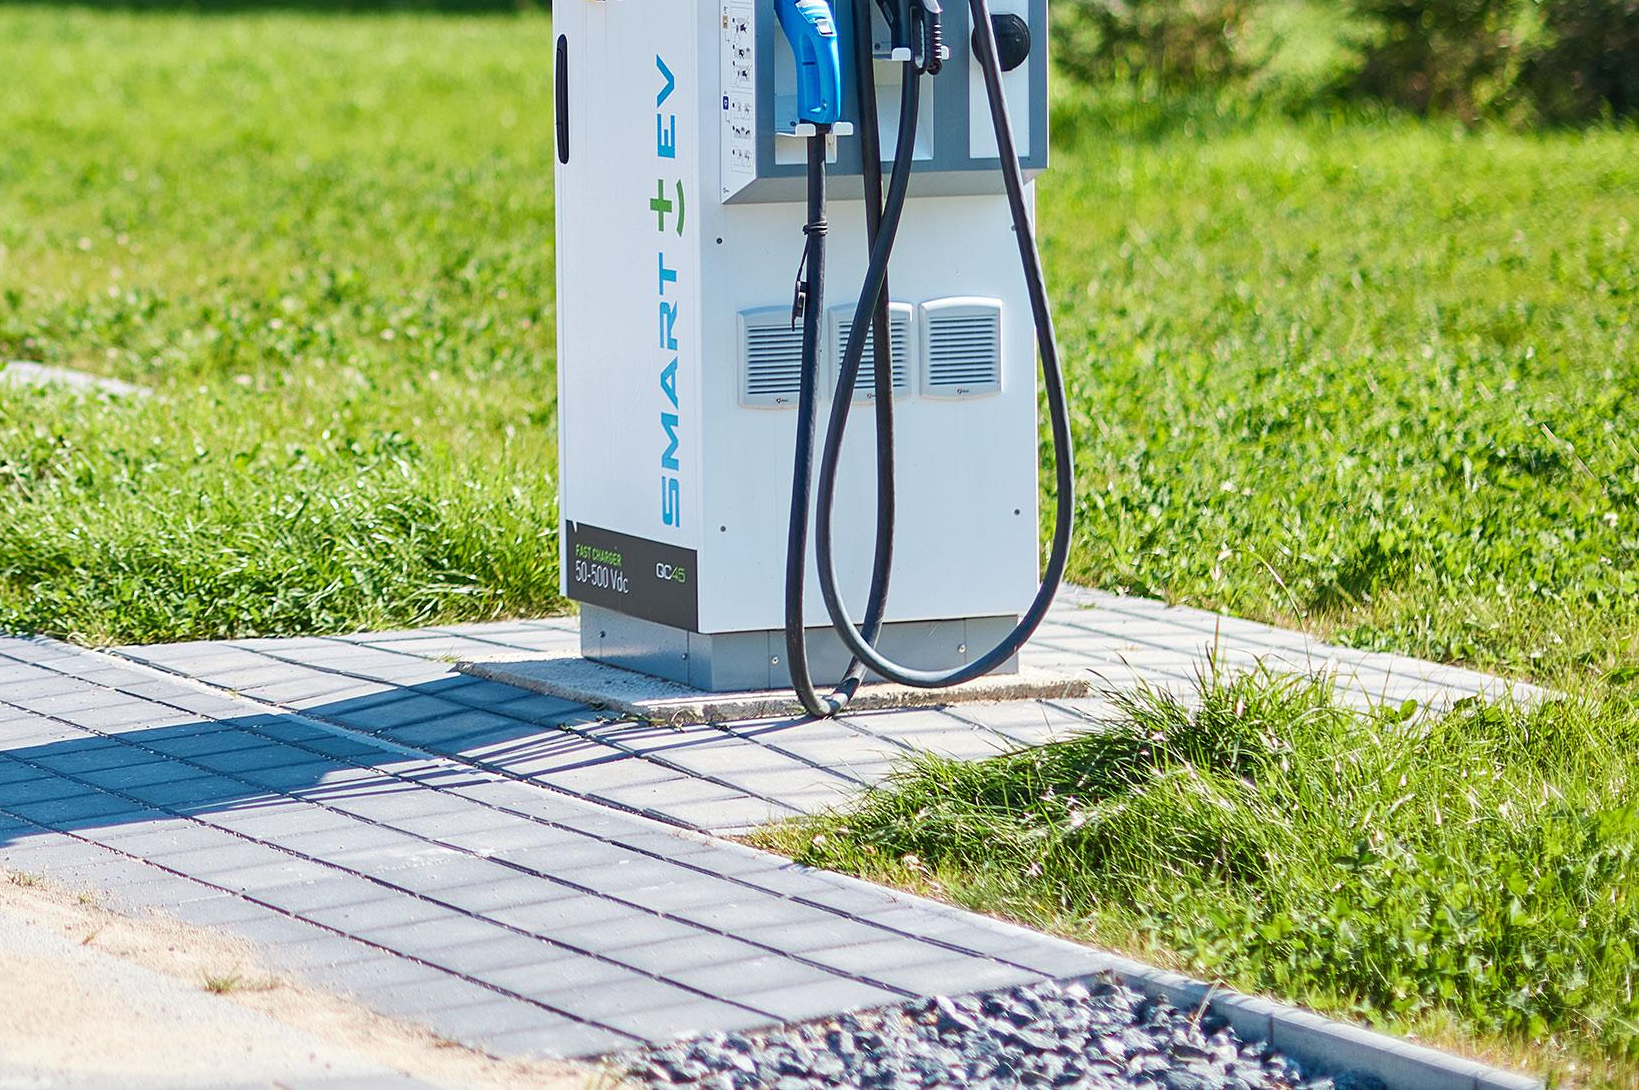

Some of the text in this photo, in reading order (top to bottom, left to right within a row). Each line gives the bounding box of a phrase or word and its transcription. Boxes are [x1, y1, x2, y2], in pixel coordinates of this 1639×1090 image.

[655, 53, 681, 528] SMART EV
[575, 542, 622, 568] FAST CHARGER
[575, 559, 629, 594] 50-500 Vdc
